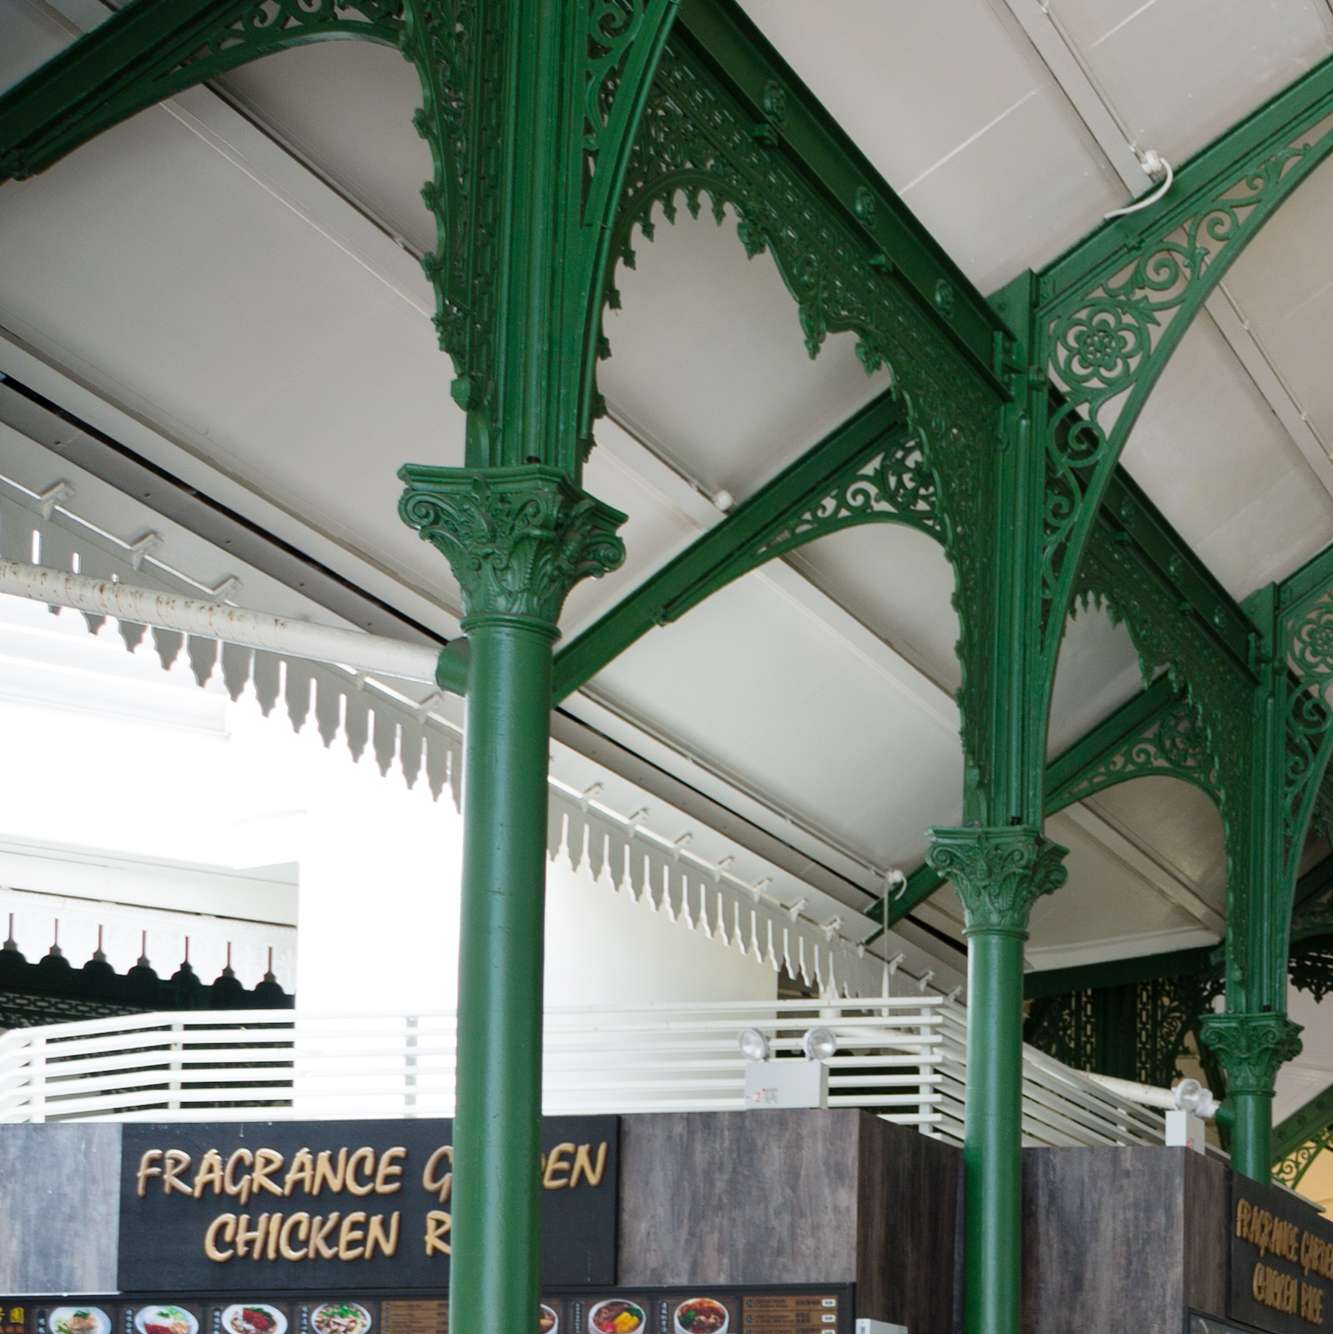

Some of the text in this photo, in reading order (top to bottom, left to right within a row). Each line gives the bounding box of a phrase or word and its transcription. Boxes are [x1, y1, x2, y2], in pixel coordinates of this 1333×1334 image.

[136, 1141, 607, 1205] FRAGRANCE GEN
[204, 1211, 401, 1262] CHICKEN
